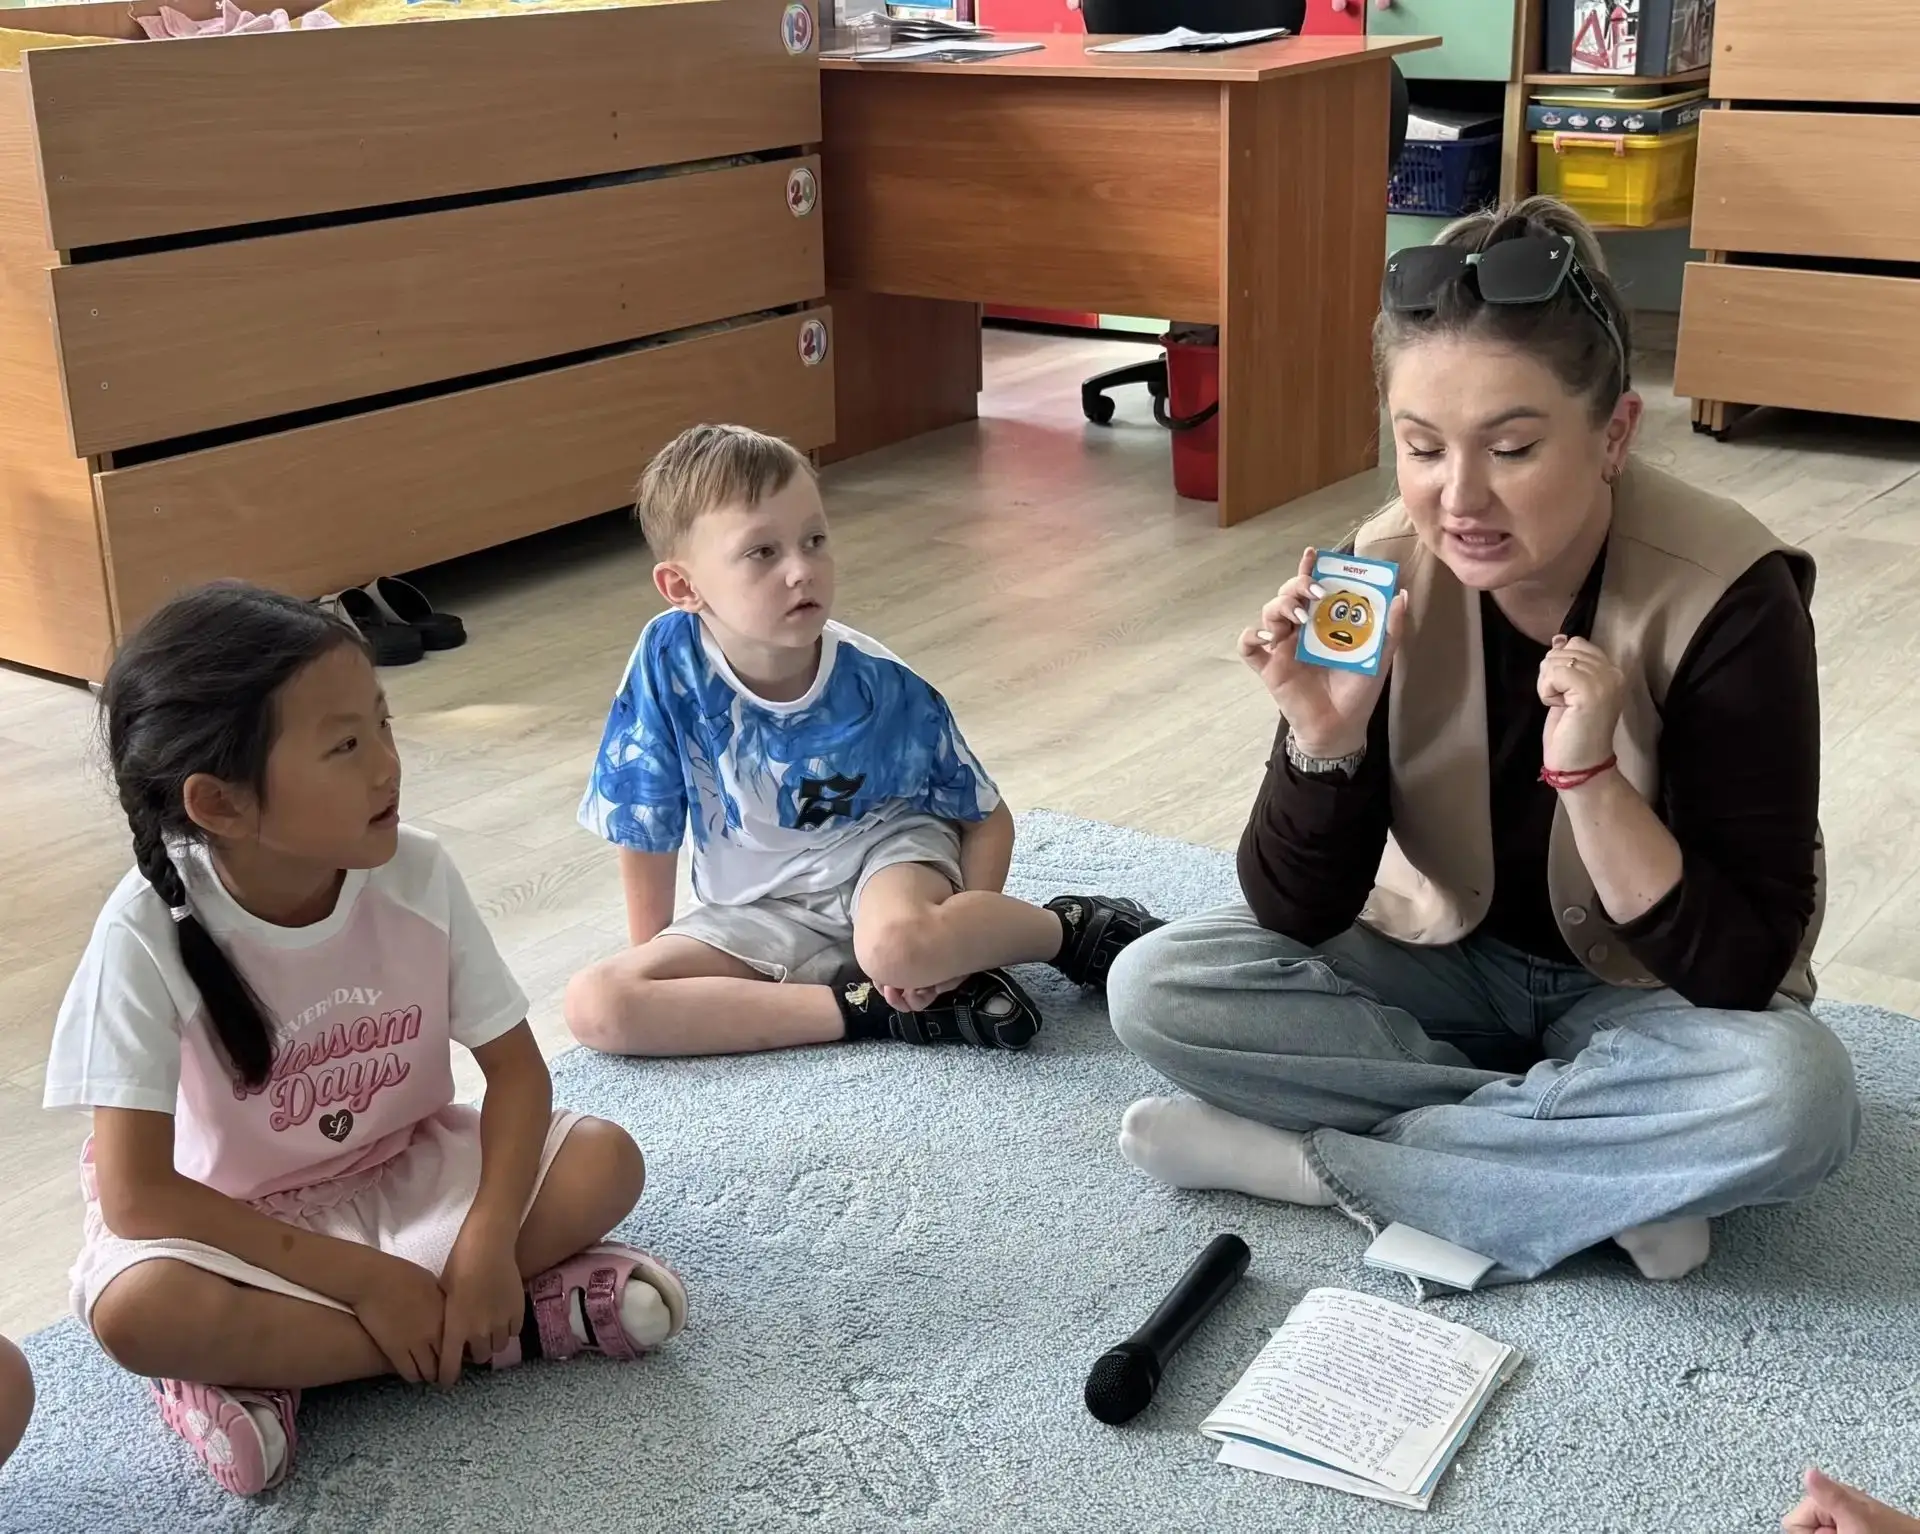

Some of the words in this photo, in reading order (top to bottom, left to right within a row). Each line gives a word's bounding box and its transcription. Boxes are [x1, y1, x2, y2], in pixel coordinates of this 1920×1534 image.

[786, 12, 807, 47] 19
[790, 177, 812, 206] 20
[803, 327, 821, 358] 21
[1343, 565, 1368, 575] ИСПУГ
[270, 1052, 411, 1132] Days
